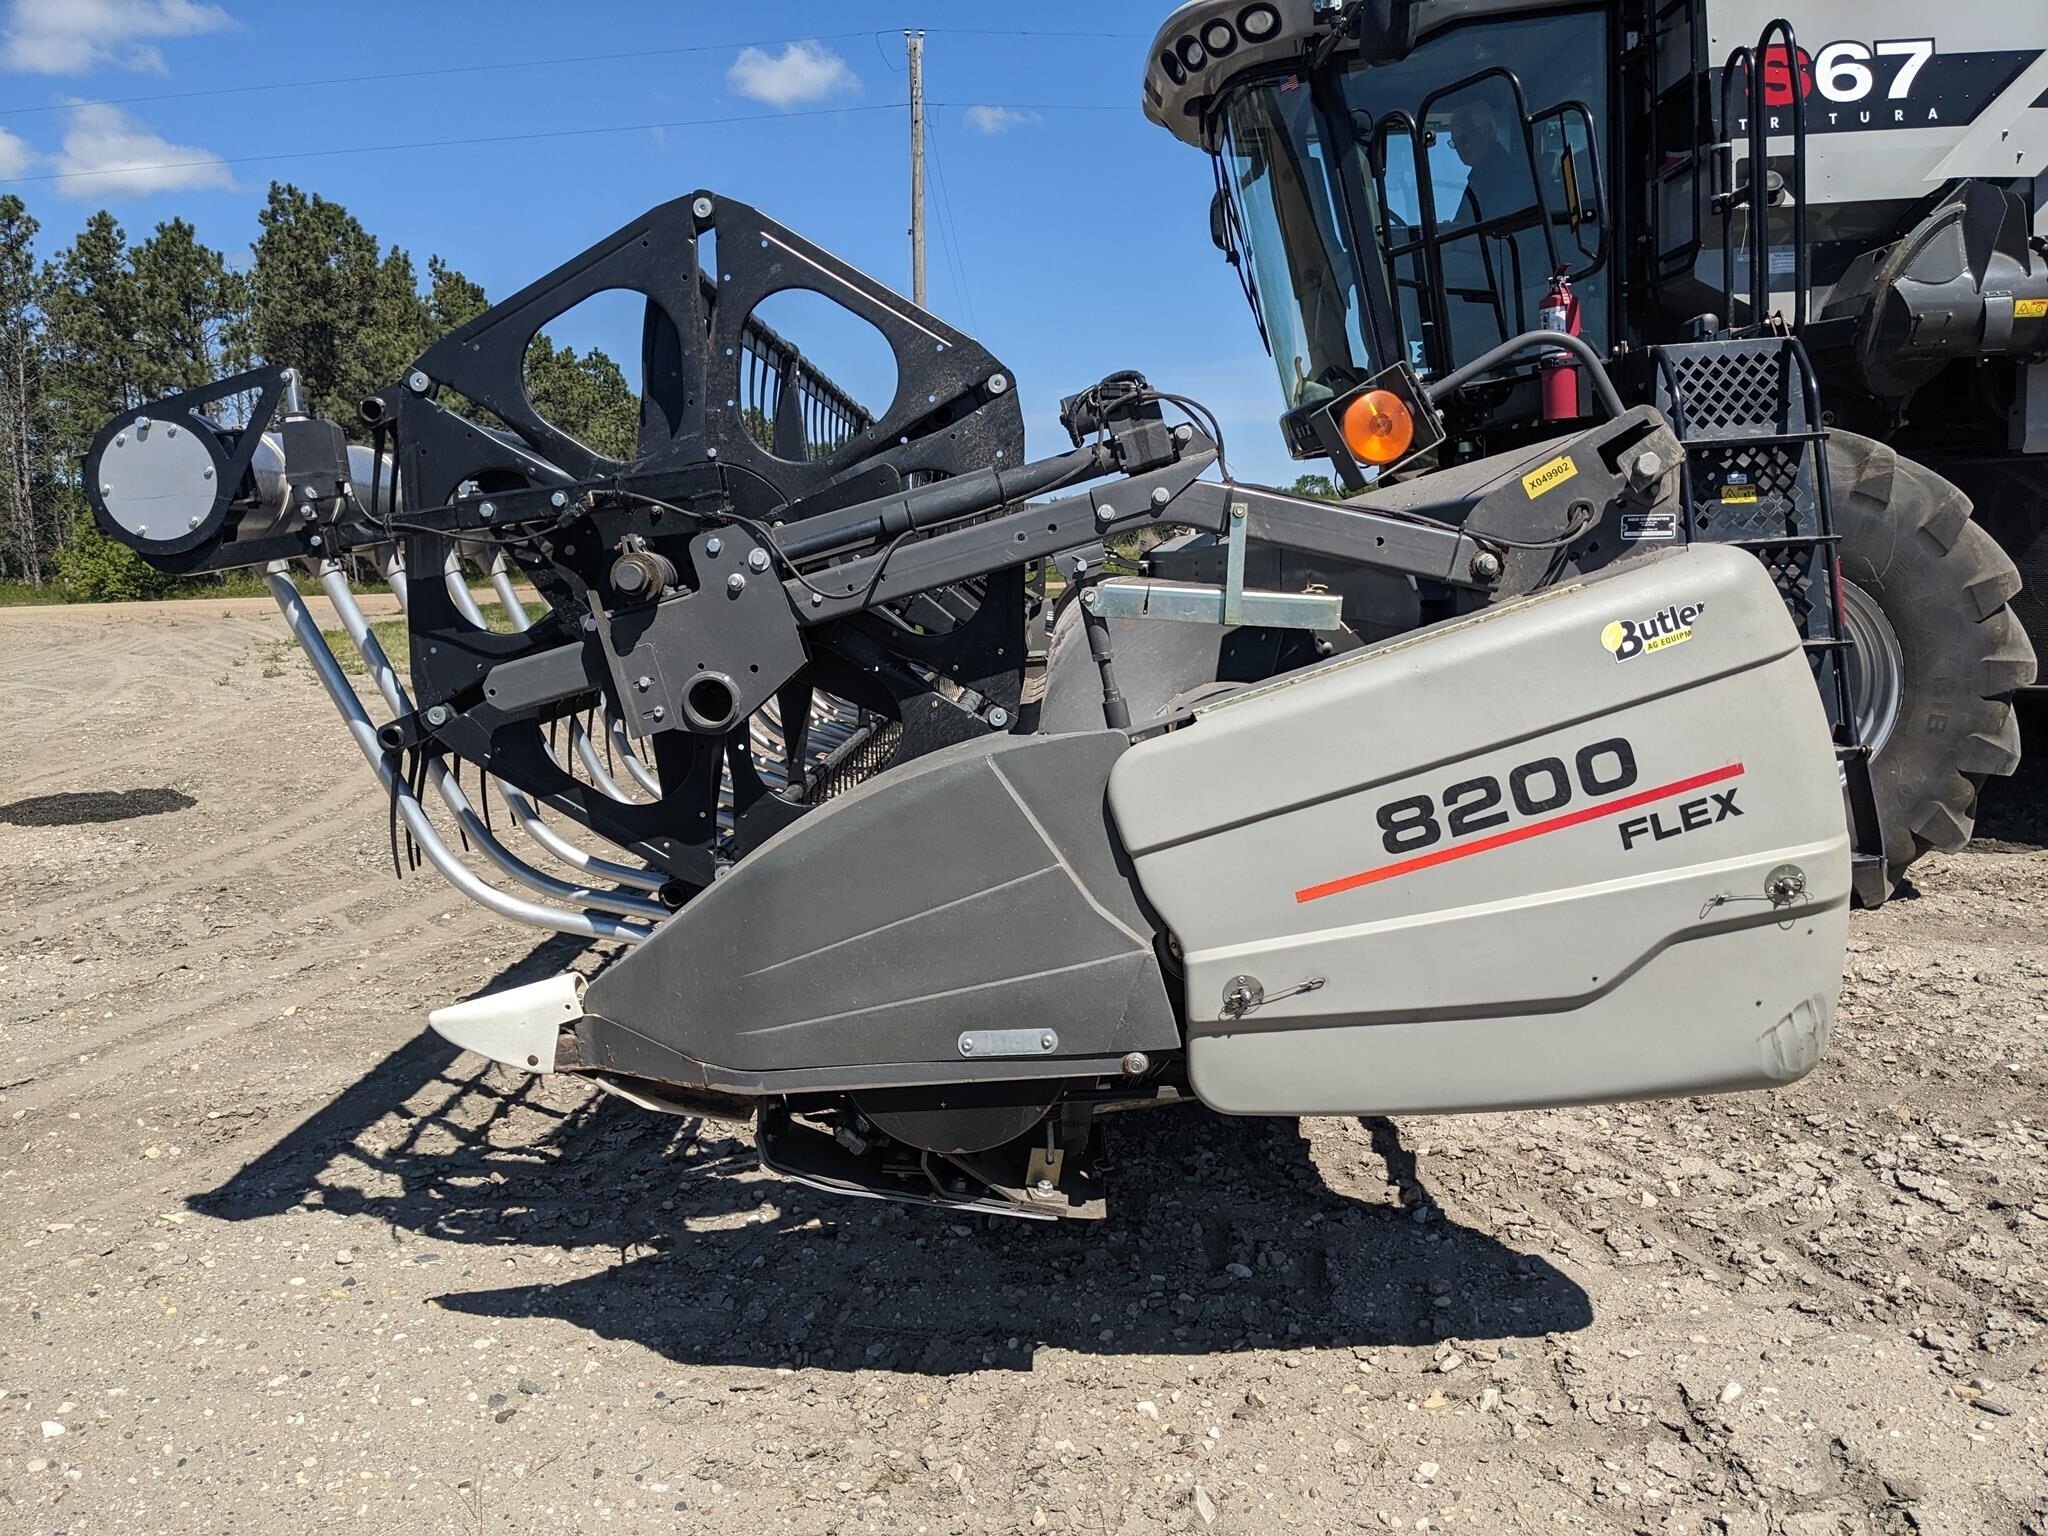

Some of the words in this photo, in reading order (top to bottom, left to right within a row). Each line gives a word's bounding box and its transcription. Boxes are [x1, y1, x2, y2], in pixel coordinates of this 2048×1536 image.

[1745, 38, 1935, 106] S67
[1739, 108, 1938, 131] TRTURA
[1529, 462, 1569, 490] X049902
[1615, 602, 1704, 661] Butler
[1647, 641, 1659, 651] AG
[1376, 737, 1638, 854] 8200
[1618, 787, 1744, 850] FLEX
